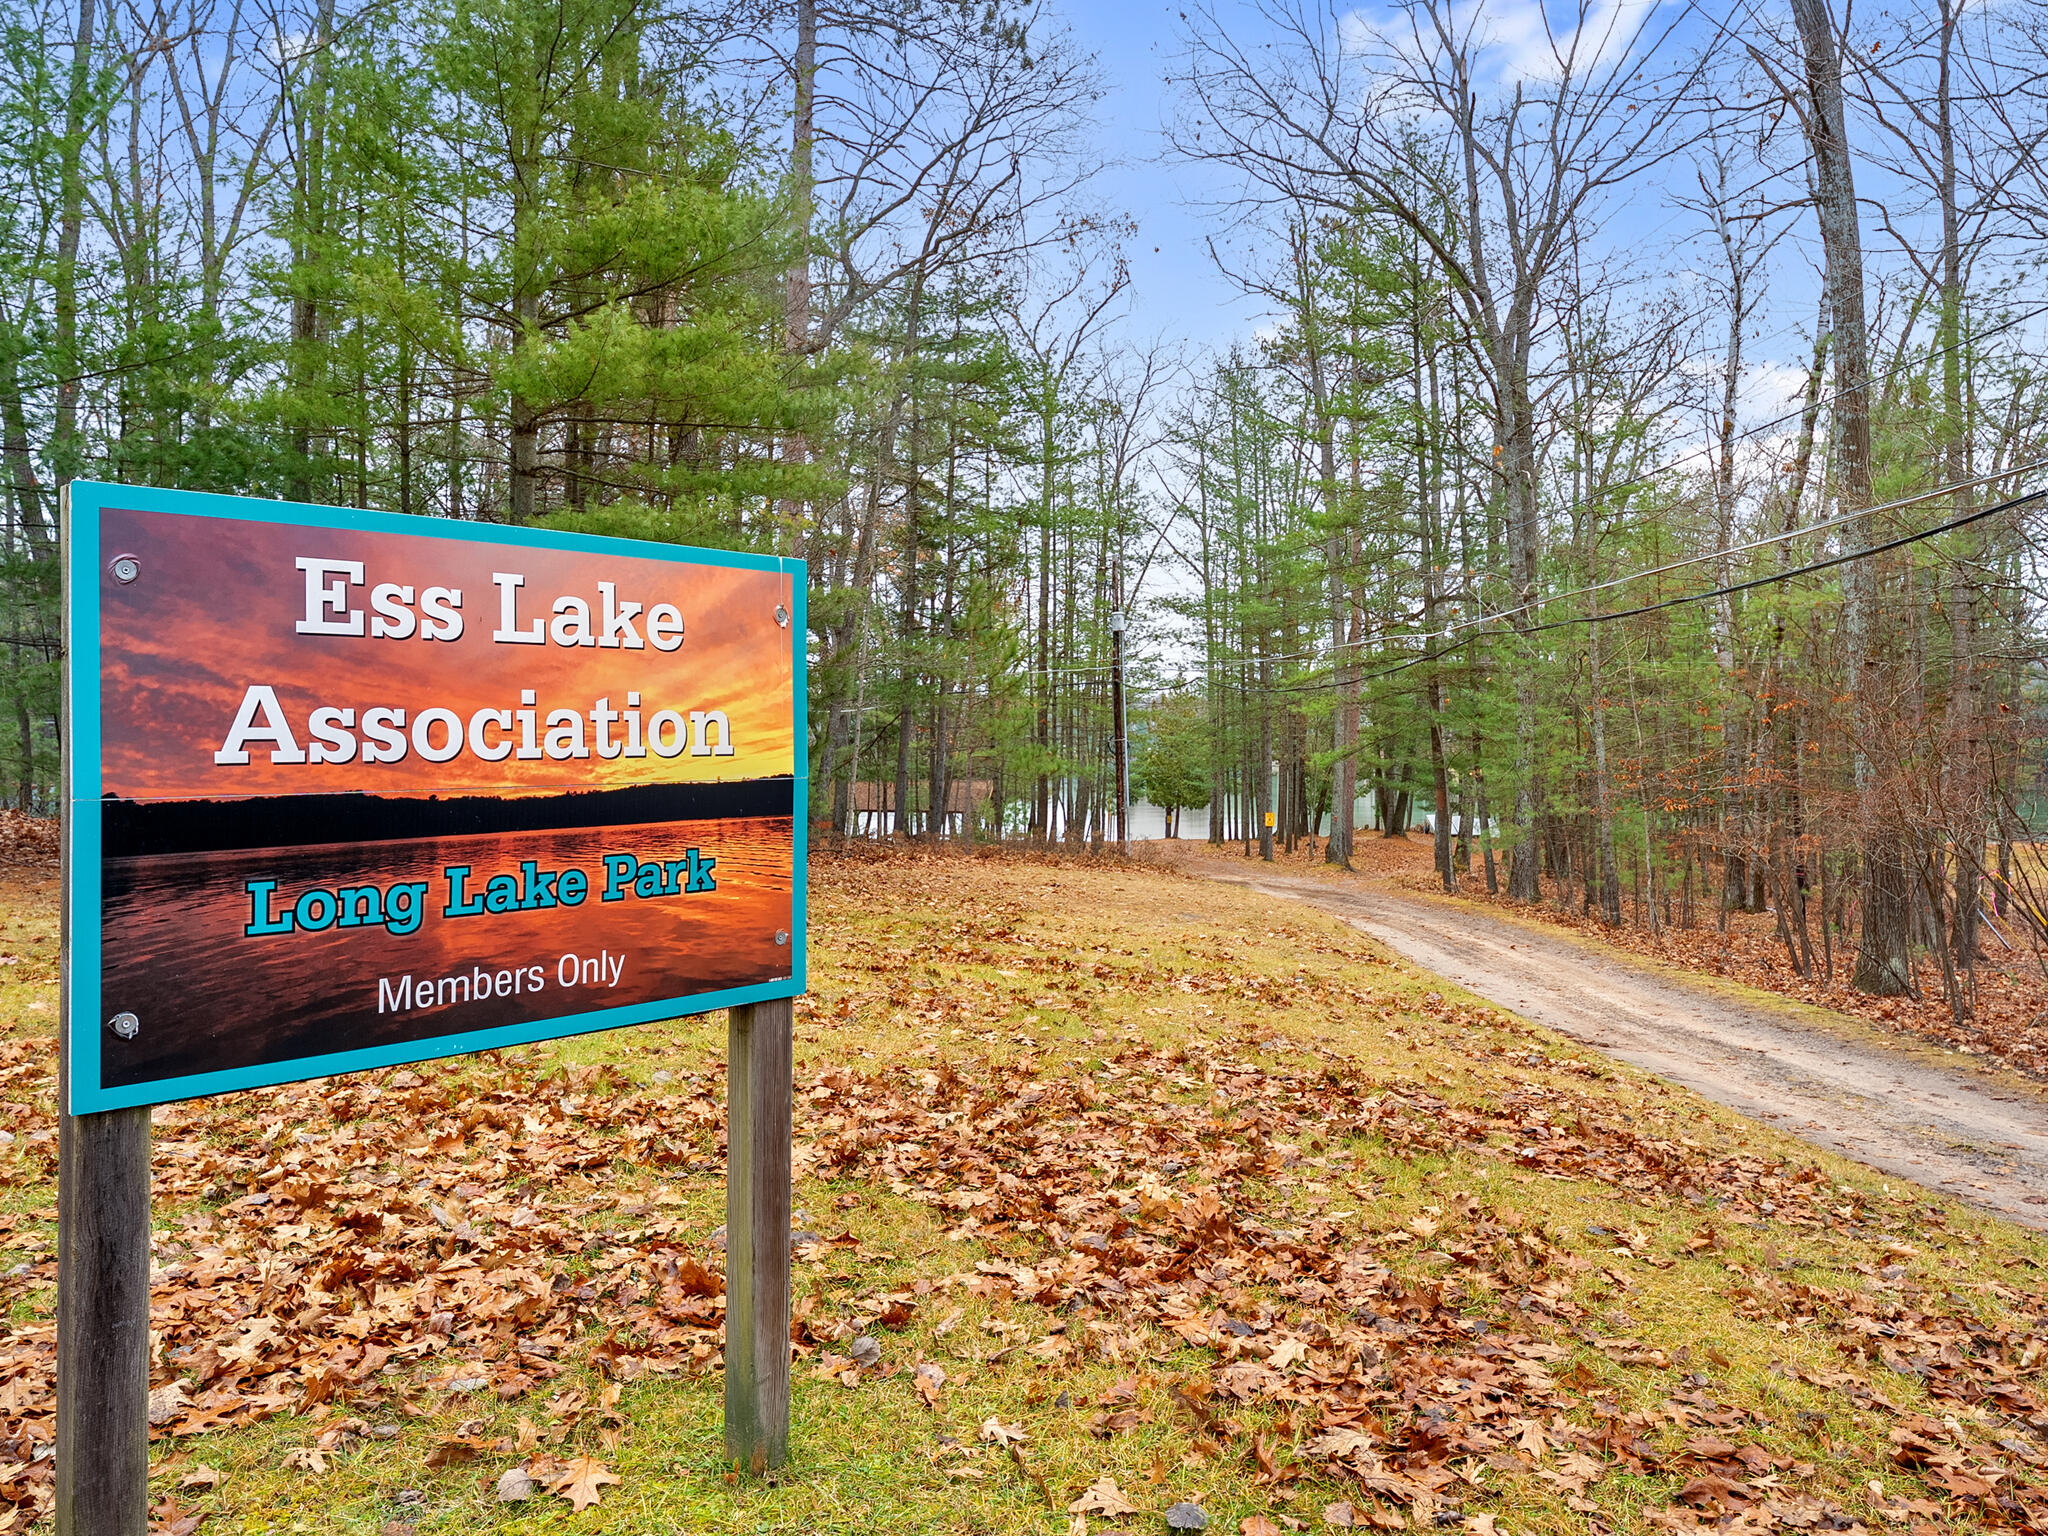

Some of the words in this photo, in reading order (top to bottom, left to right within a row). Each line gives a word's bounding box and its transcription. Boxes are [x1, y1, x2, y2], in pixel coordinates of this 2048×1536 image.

[295, 556, 464, 642] Ess
[492, 572, 685, 652] Lake
[213, 685, 735, 766] Association
[244, 878, 428, 938] Long
[443, 860, 588, 918] Lake
[601, 847, 716, 902] Park
[377, 962, 545, 1014] Members
[557, 949, 626, 988] Only
